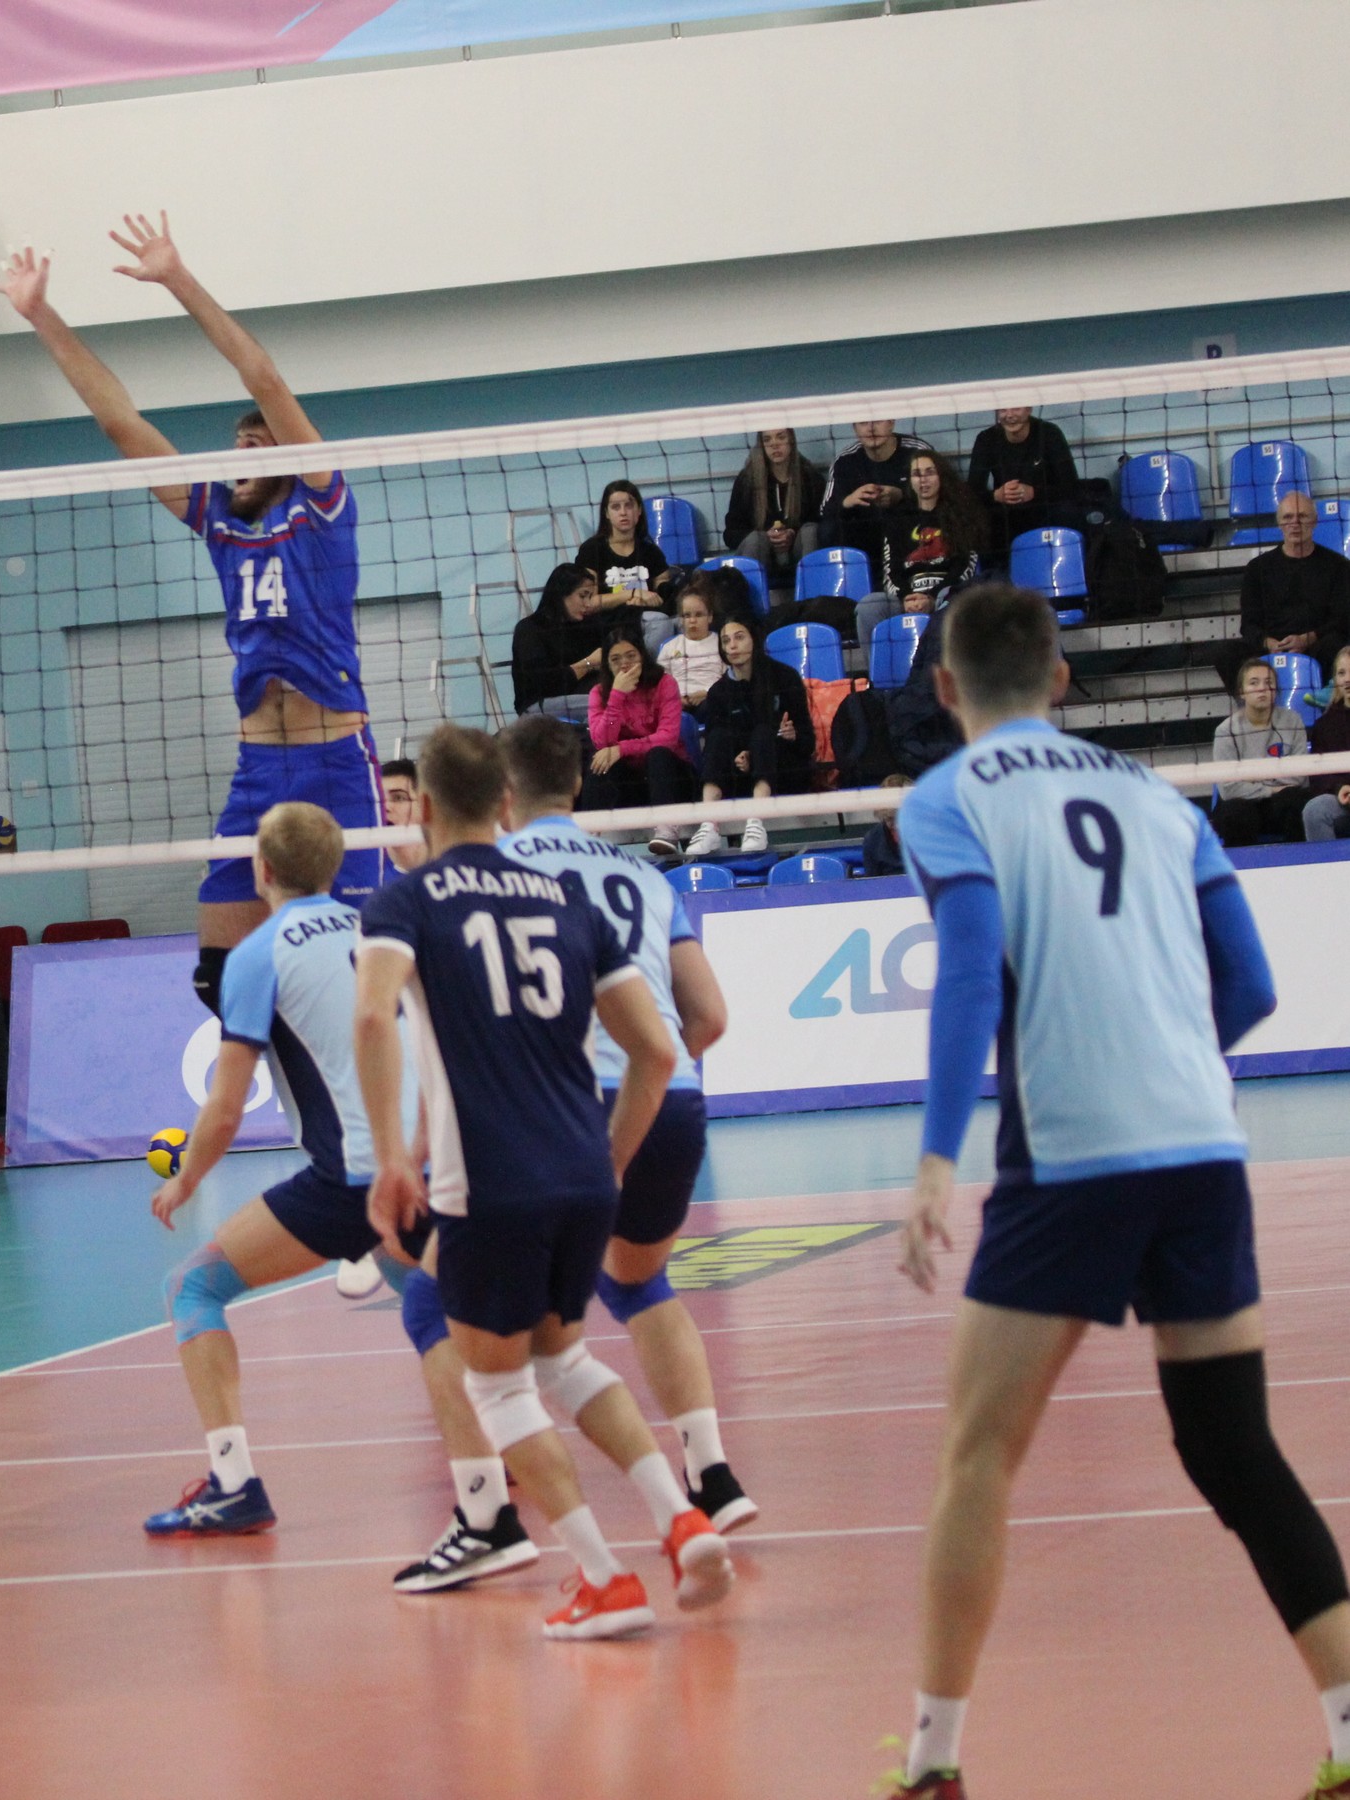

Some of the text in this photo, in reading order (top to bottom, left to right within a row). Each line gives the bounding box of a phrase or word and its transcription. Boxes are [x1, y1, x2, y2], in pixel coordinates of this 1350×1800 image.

[239, 556, 288, 621] 14
[970, 745, 1149, 784] САХАЛИН
[423, 864, 567, 907] САХАЛИН
[1063, 798, 1125, 918] 9
[462, 911, 565, 1020] 15
